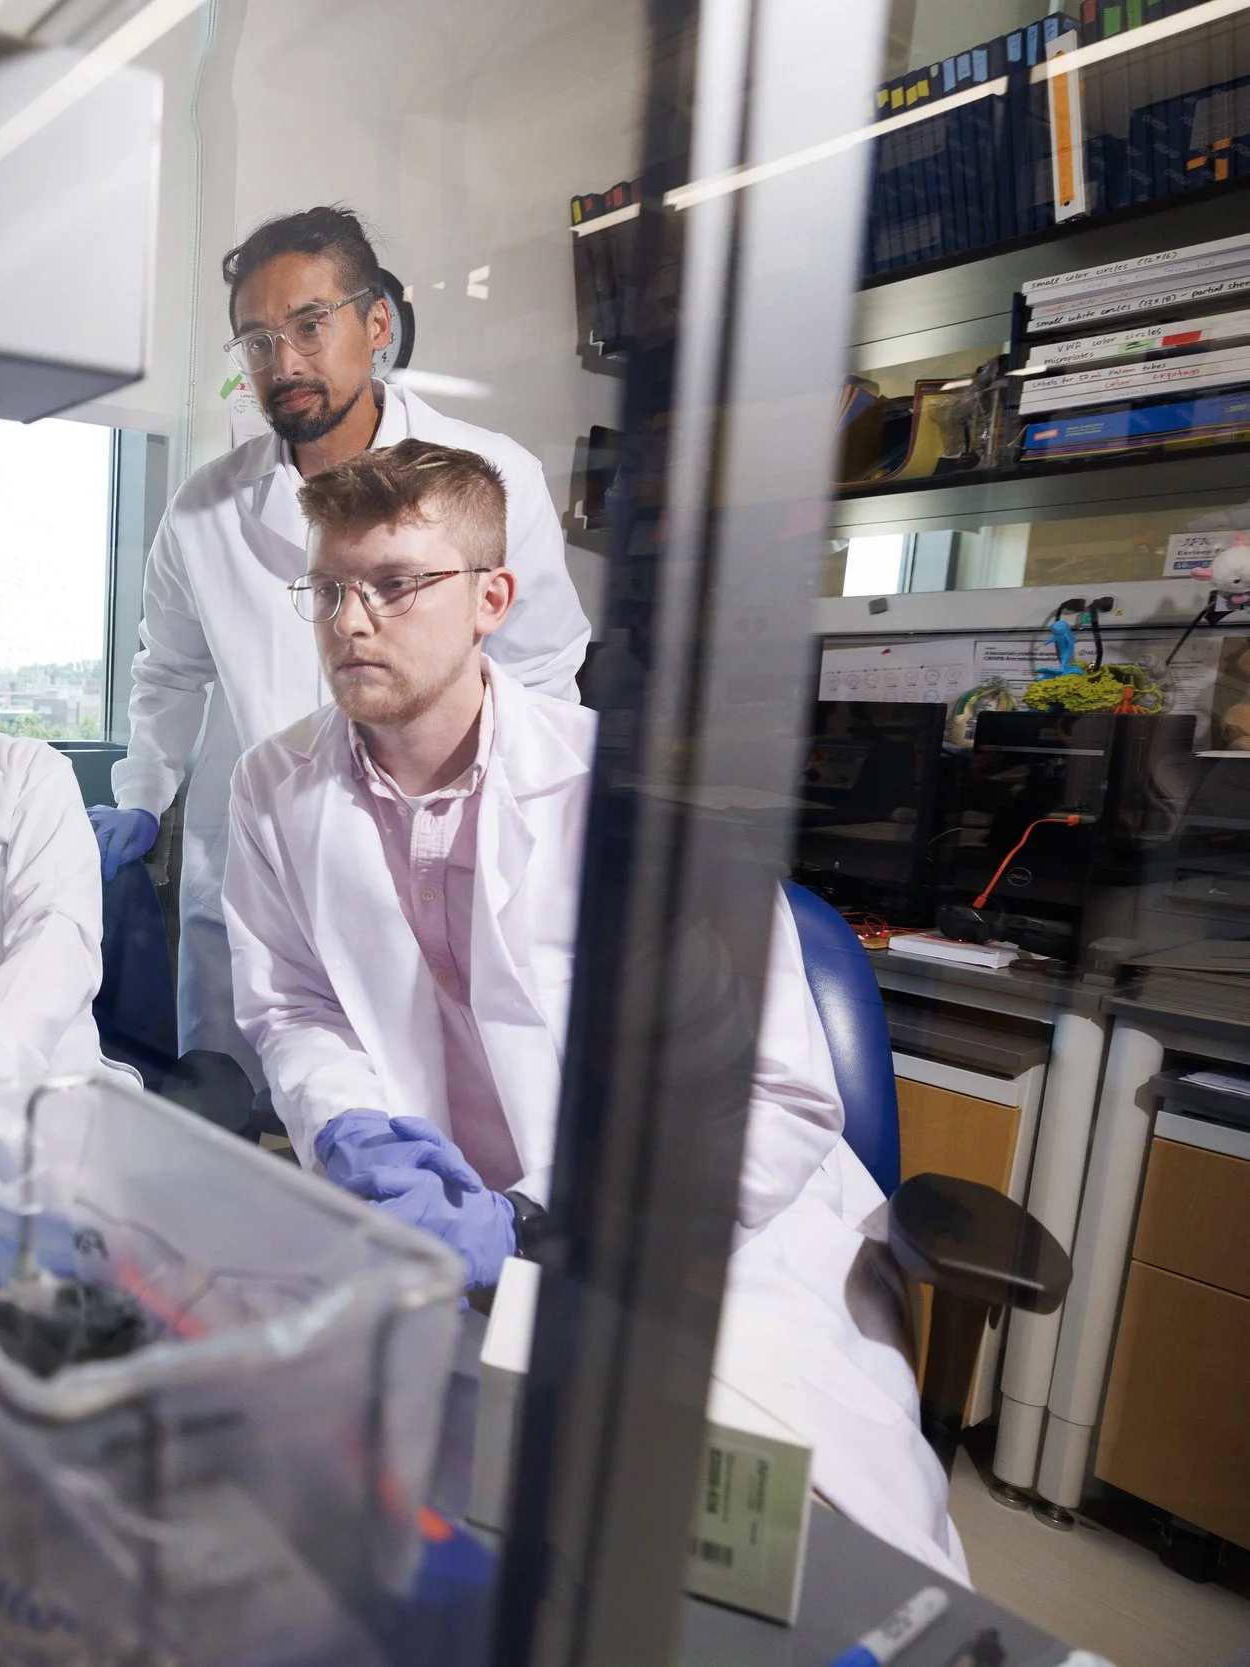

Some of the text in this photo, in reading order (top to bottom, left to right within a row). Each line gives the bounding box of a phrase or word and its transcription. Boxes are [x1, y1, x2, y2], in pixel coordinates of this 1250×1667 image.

[1031, 278, 1059, 289] small
[1066, 272, 1090, 281] color
[1096, 263, 1128, 275] circles
[1036, 316, 1064, 328] small
[1068, 310, 1096, 322] white
[1192, 283, 1224, 298] partial
[1057, 328, 1162, 353] VWR color circles
[381, 351, 388, 363] 4
[1142, 362, 1167, 371] tubes
[1180, 536, 1214, 546] JFK
